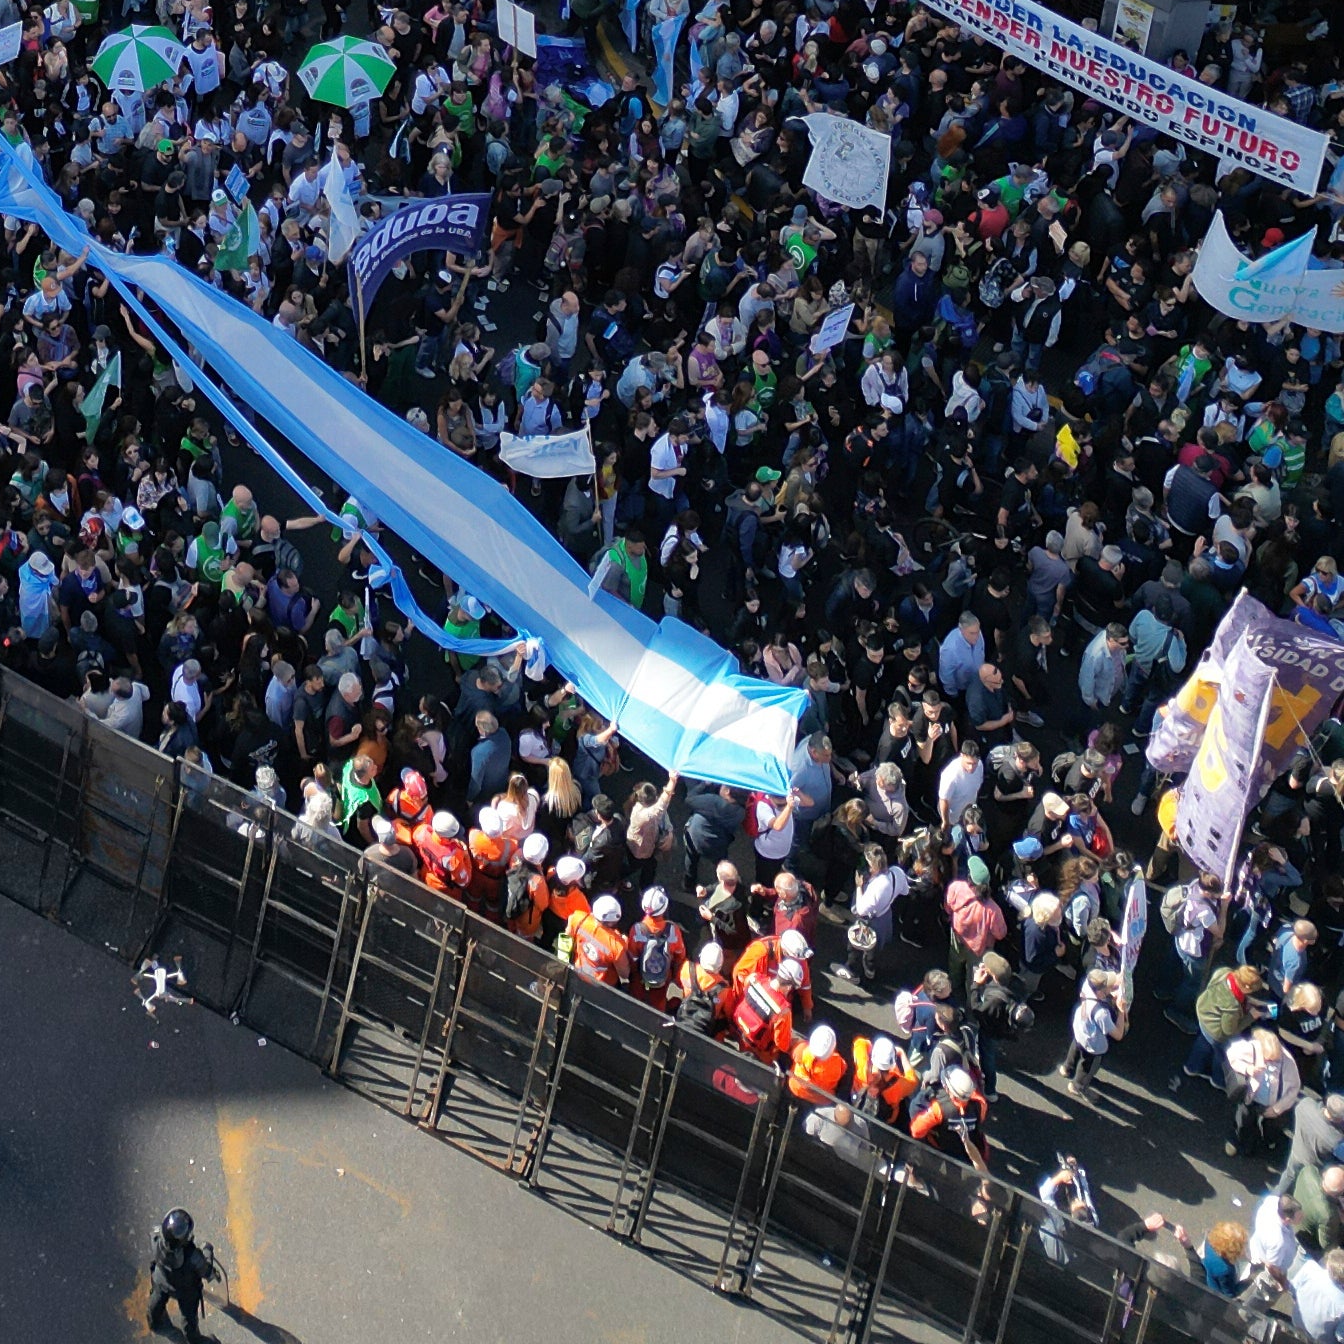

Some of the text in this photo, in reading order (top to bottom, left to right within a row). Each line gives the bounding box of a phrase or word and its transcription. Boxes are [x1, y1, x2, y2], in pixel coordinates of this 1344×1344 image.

[1033, 51, 1159, 123] FERNANDO
[1168, 120, 1298, 184] ESPINOZA
[1049, 41, 1175, 116] NUESTRO
[1182, 107, 1302, 174] FUTURO
[1052, 24, 1085, 57] LA
[1093, 39, 1259, 133] EDUCACION
[350, 203, 479, 277] eduba
[448, 227, 472, 238] UBA
